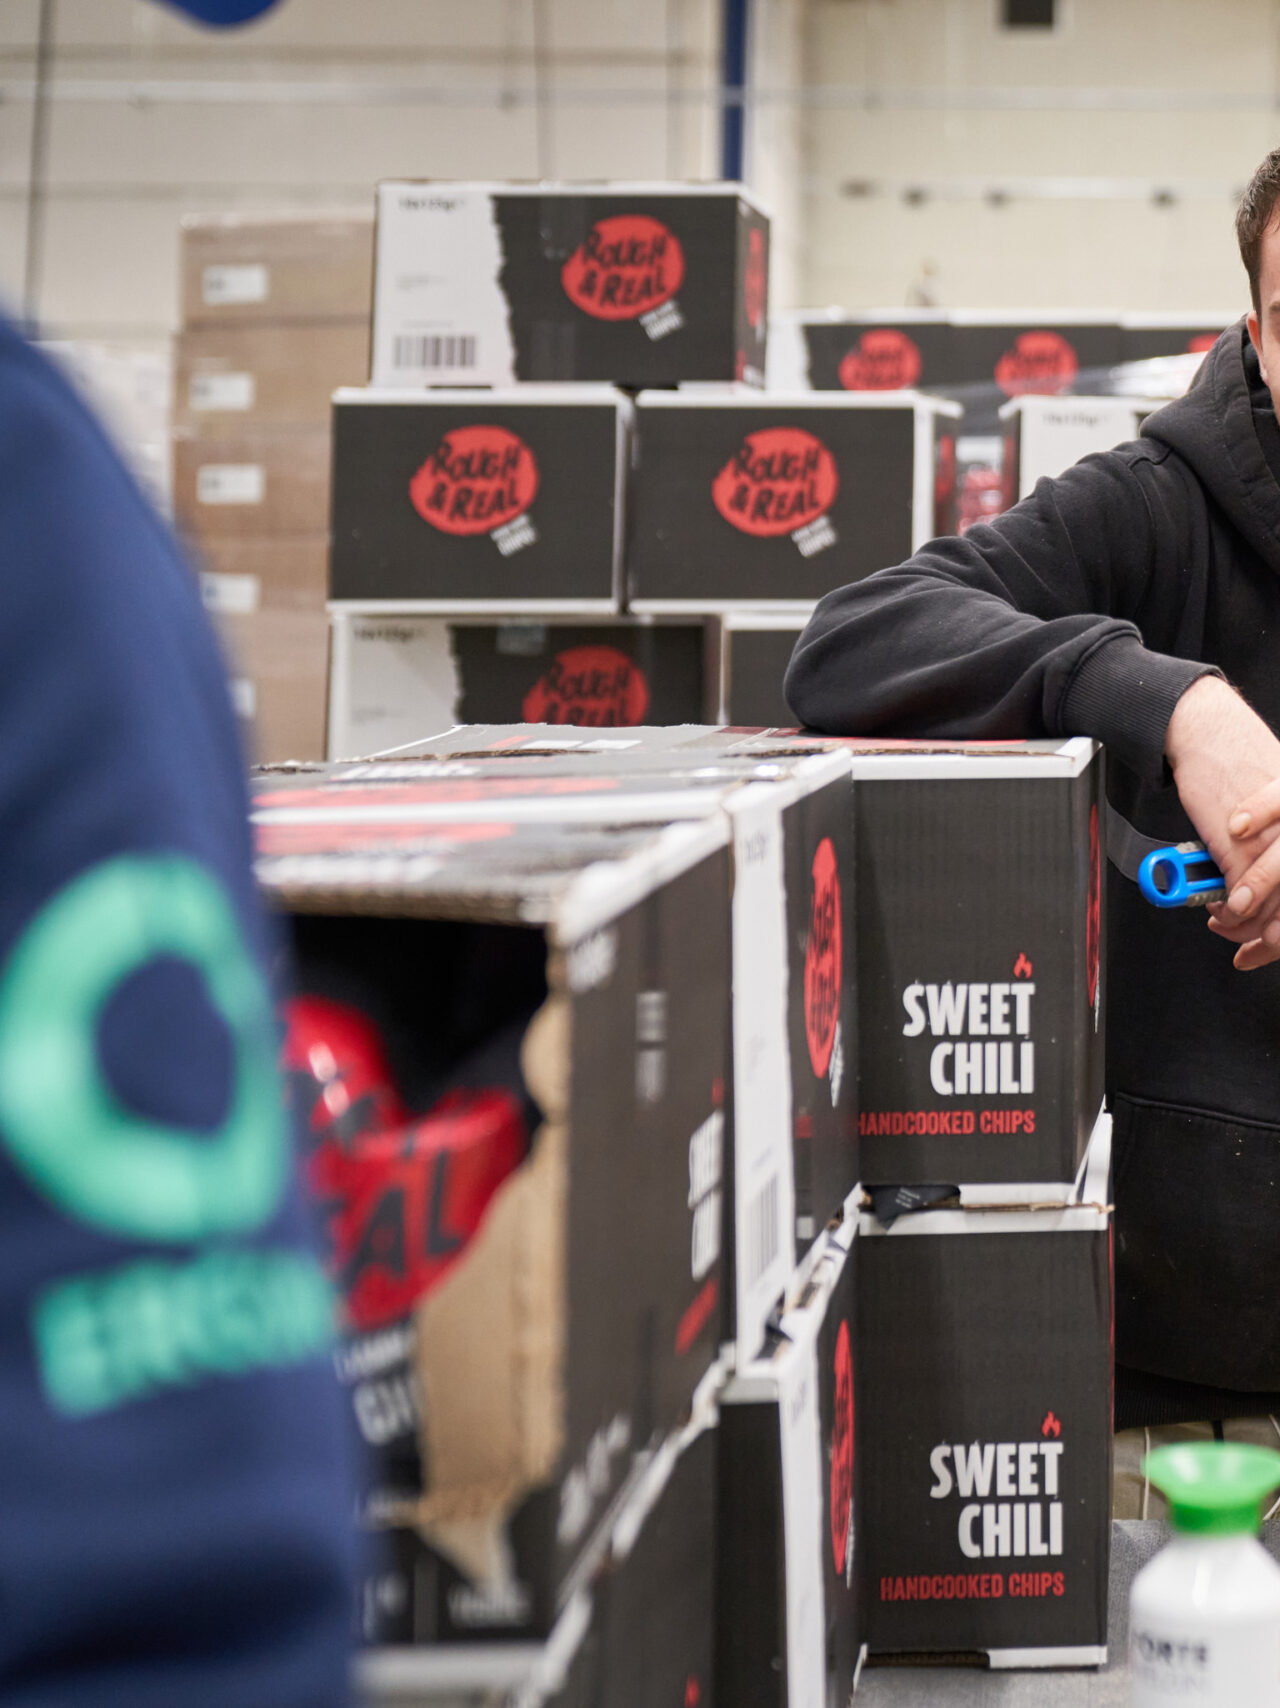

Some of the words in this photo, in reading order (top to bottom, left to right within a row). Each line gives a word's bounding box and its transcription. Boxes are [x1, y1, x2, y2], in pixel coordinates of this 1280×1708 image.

[582, 231, 667, 271] ROUGH
[578, 269, 598, 298] &
[600, 261, 667, 308] REAL
[431, 442, 521, 483] ROUGH
[733, 442, 821, 483] ROUGH
[427, 481, 447, 512] &
[450, 477, 520, 520] REAL
[730, 485, 749, 513] &
[752, 479, 821, 521] REAL
[543, 662, 630, 699] ROUGH
[902, 982, 1036, 1037] SWEET
[930, 1042, 1034, 1095] CHILI
[858, 1111, 976, 1136] HANDCOOKED
[979, 1109, 1036, 1135] CHIPS
[930, 1441, 1064, 1499] SWEET
[958, 1503, 1063, 1558] CHILI
[880, 1574, 1004, 1601] HANDCOOKED
[1008, 1571, 1065, 1598] CHIPS
